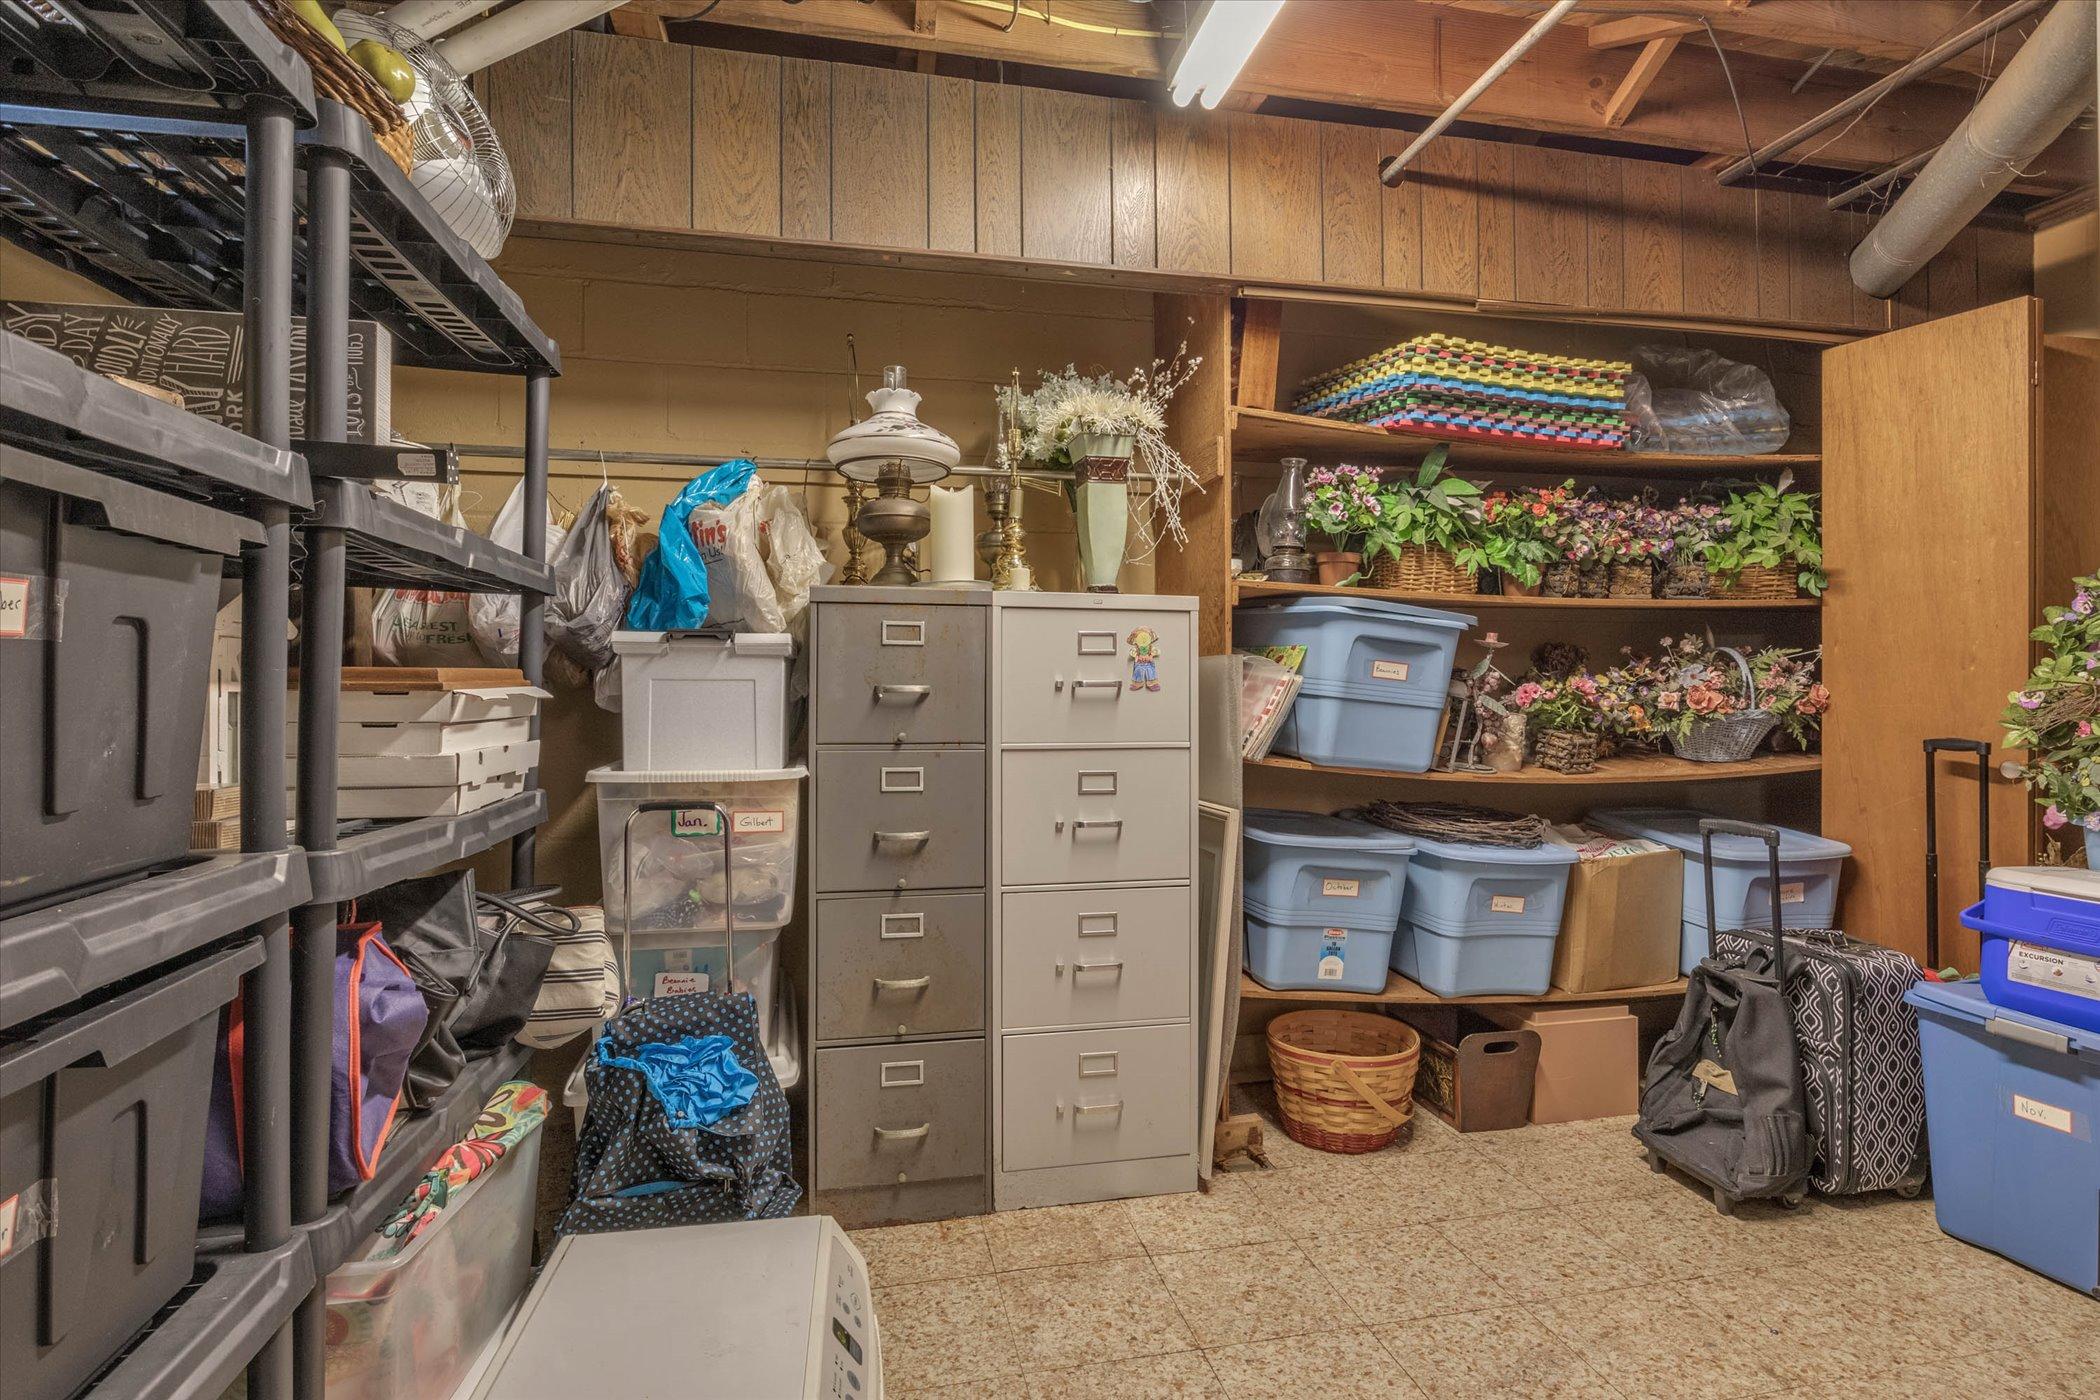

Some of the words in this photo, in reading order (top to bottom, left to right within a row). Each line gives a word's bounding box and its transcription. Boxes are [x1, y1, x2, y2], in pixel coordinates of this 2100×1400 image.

[60, 313, 105, 352] DAY
[94, 321, 148, 377] OUDLY
[163, 325, 231, 377] HARD
[678, 810, 708, 827] Jan.
[740, 816, 774, 827] Gilbert
[2019, 951, 2064, 965] EXCURSION
[2021, 1101, 2047, 1120] Nov.
